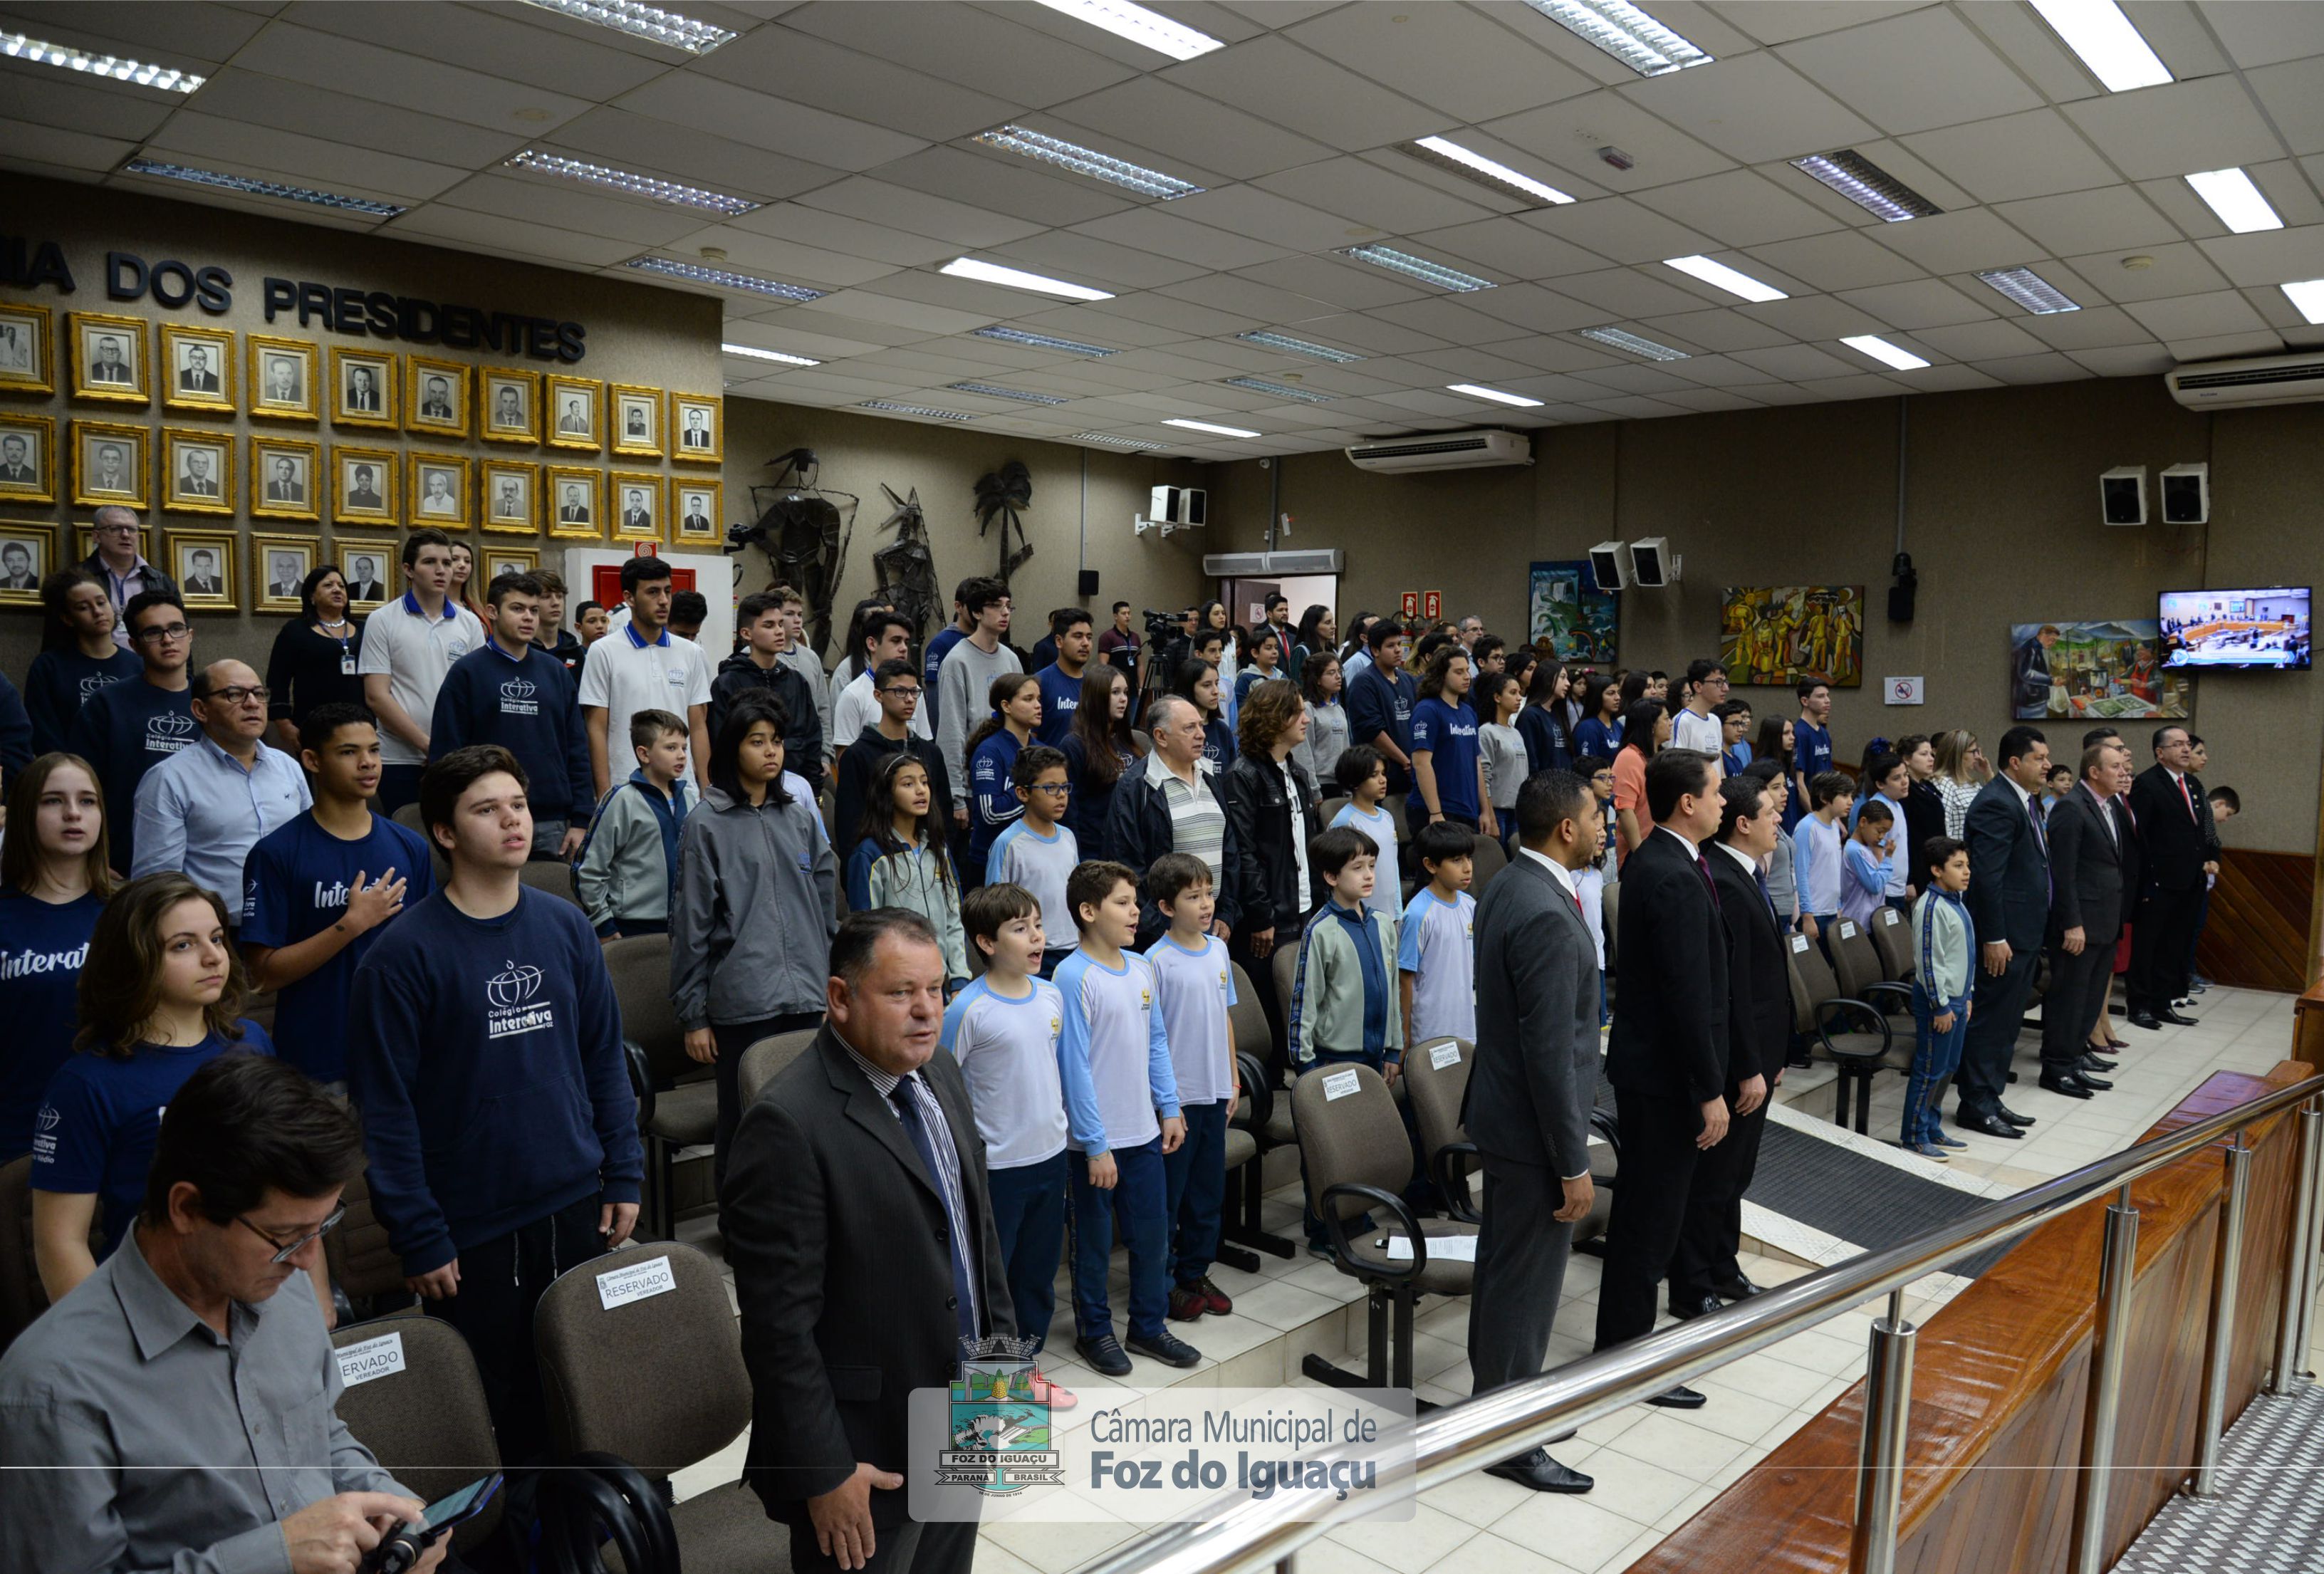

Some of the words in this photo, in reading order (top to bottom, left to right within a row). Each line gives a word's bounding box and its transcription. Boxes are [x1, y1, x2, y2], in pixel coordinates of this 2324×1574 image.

[0, 236, 76, 291] IA
[108, 251, 233, 313] DOS
[264, 276, 586, 361] PRESIDENTES
[501, 702, 538, 713] Interativa
[488, 1005, 521, 1018] Colégio
[605, 1272, 669, 1298] RESERVADO
[637, 1285, 663, 1296] VEREADOR
[343, 1351, 398, 1376] ERVADO
[355, 1366, 390, 1380] VEREADOR
